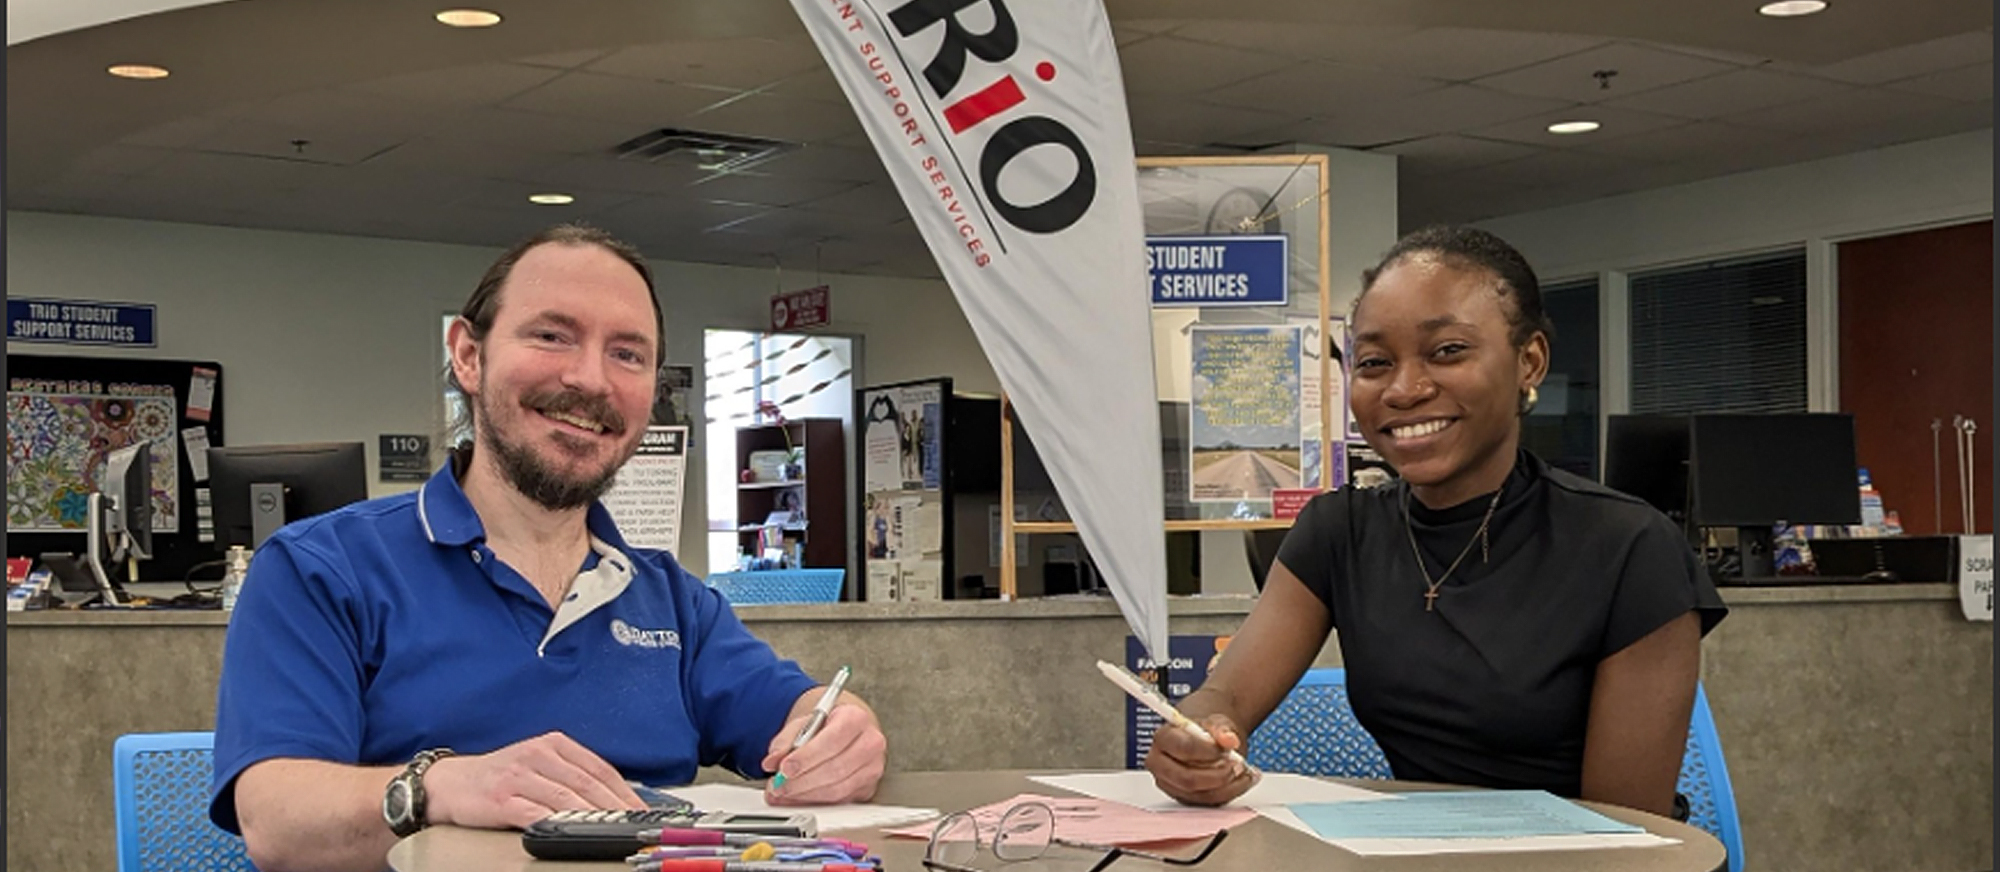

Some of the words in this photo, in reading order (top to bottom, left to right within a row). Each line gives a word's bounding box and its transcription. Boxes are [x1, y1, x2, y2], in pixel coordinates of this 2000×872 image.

[860, 41, 927, 147] SUPPORT
[922, 155, 991, 268] SERVICES
[1146, 246, 1226, 270] STUDENT
[1161, 273, 1249, 298] SERVICES
[61, 305, 119, 323] STUDENT
[13, 320, 72, 338] SUPPORT
[75, 323, 135, 342] SERVICES
[391, 437, 420, 452] 110
[642, 432, 676, 445] GRAM
